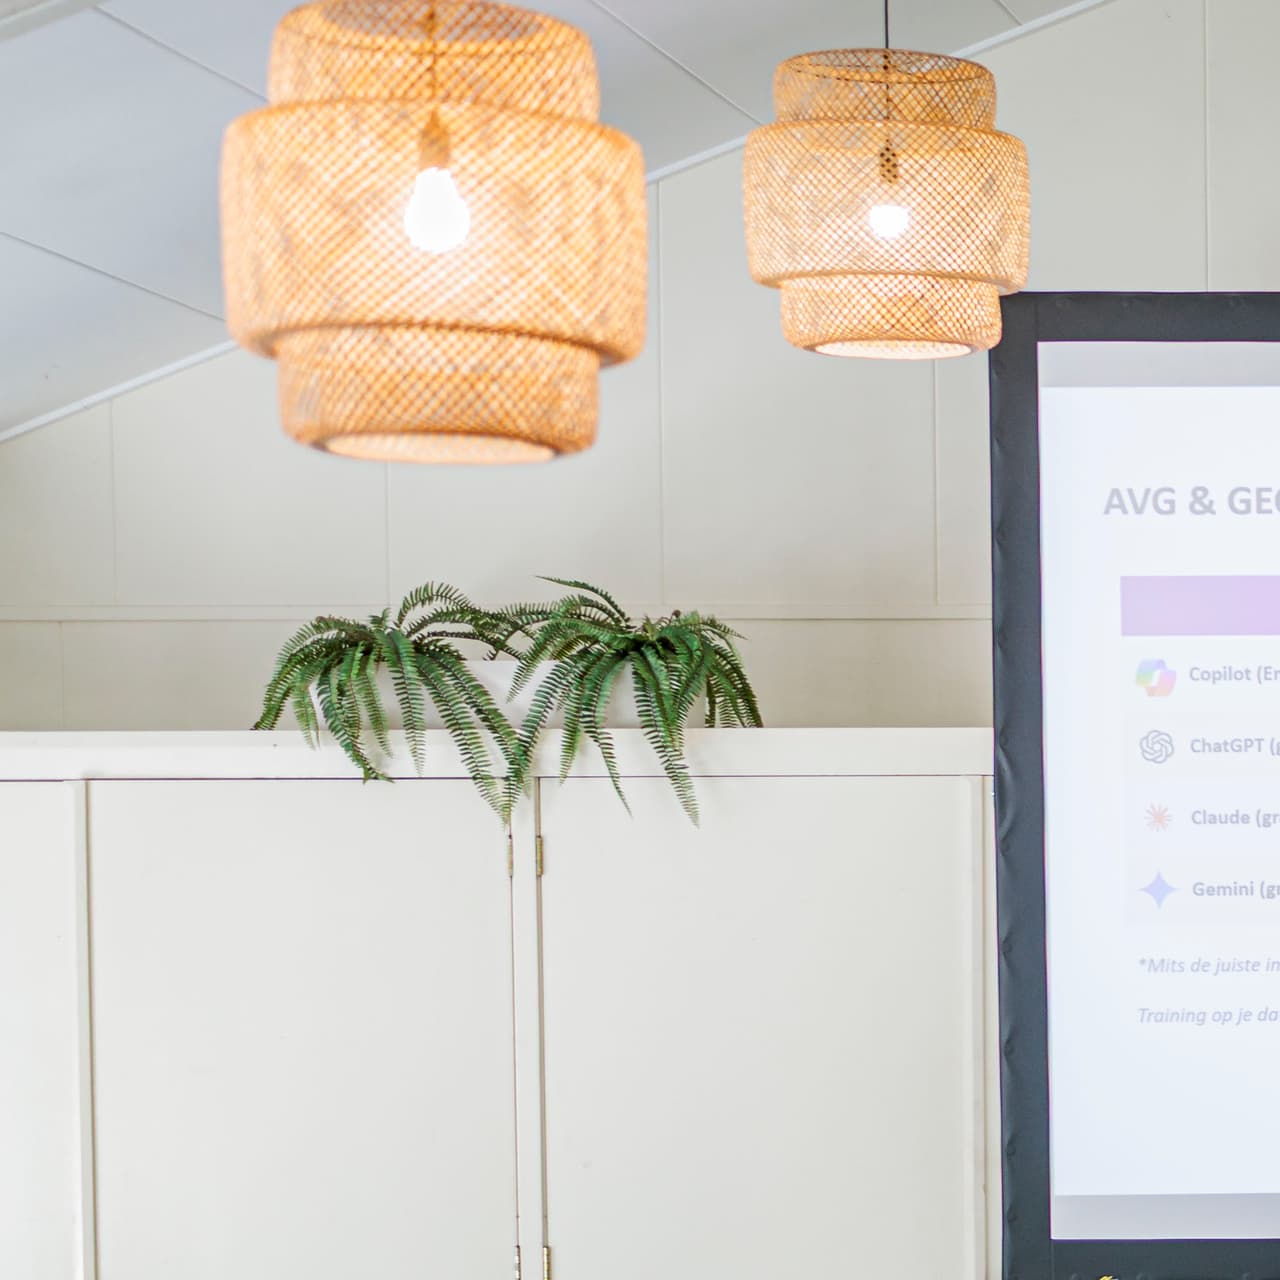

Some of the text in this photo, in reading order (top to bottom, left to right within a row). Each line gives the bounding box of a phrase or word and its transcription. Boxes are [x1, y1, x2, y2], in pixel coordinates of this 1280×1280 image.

[1103, 486, 1176, 516] AVG
[1188, 485, 1217, 516] &
[1188, 665, 1252, 685] Copilot
[1189, 737, 1265, 753] ChatGPT
[1191, 808, 1251, 825] Claude
[1192, 880, 1255, 897] Gemini
[1190, 957, 1211, 973] de
[1213, 957, 1262, 977] juiste
[1139, 1007, 1207, 1027] Training
[1211, 1010, 1233, 1026] op
[1235, 1007, 1254, 1027] je
